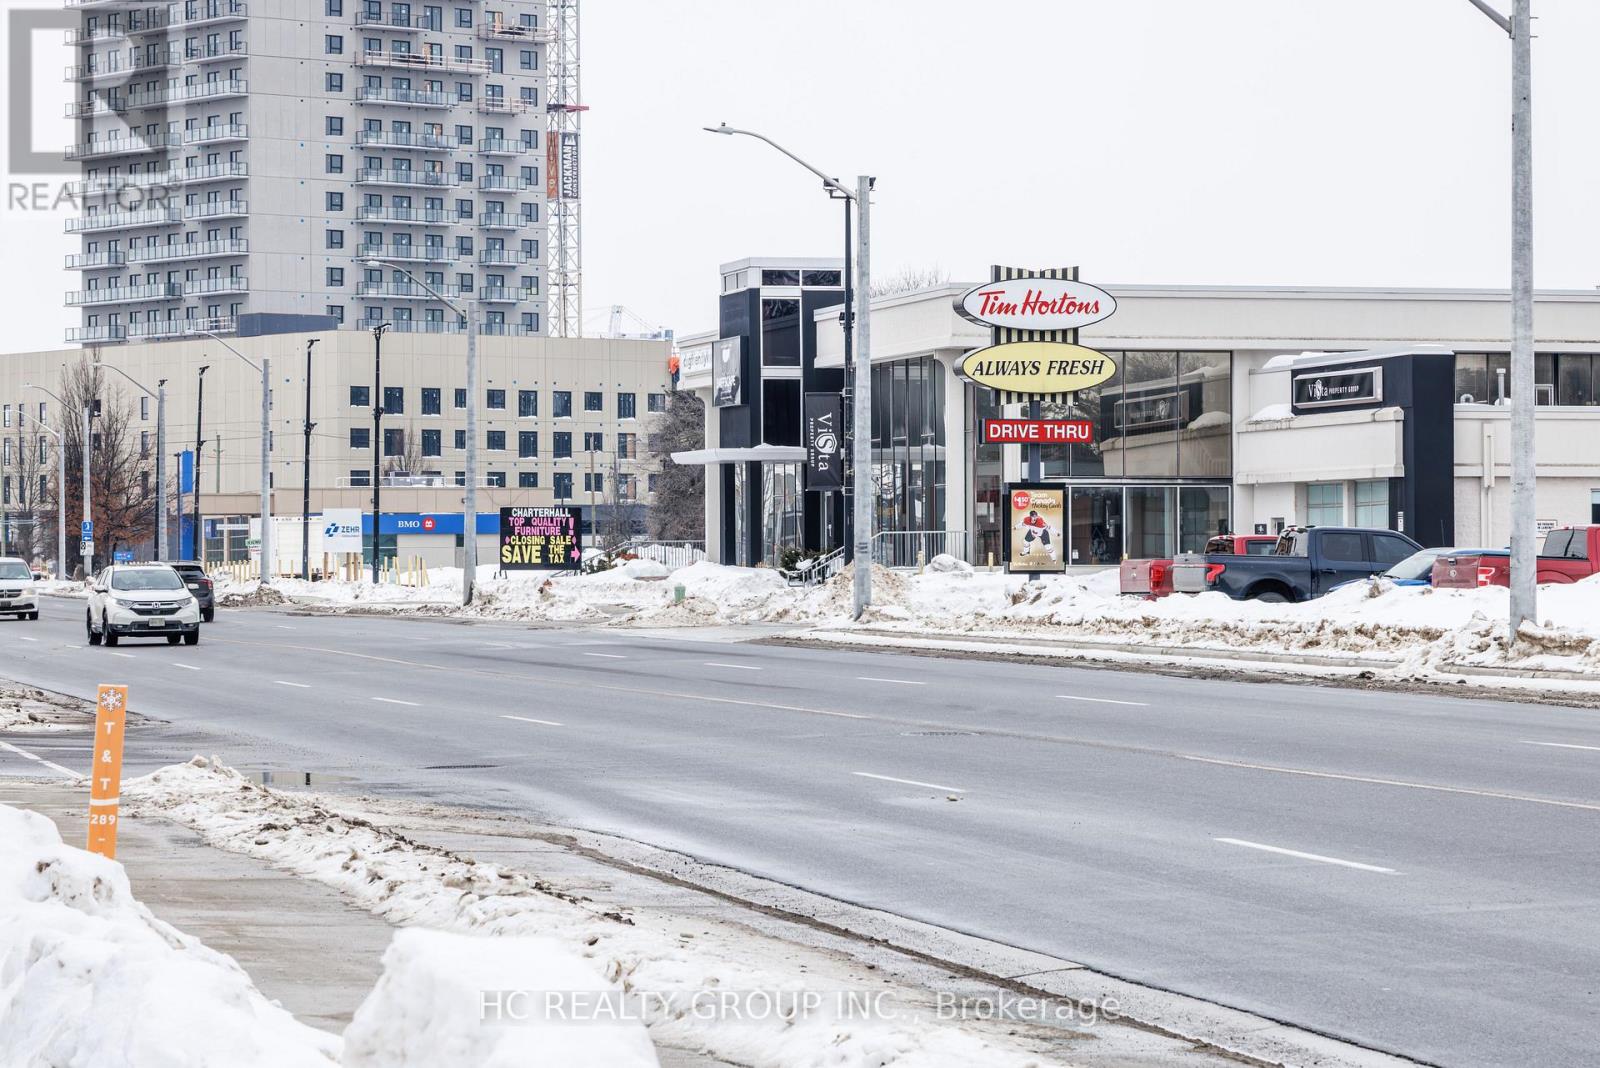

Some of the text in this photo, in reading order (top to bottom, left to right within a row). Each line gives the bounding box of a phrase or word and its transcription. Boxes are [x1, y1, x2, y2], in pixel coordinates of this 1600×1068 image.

[563, 145, 572, 197] JACKMAN
[978, 289, 1100, 316] Tim Hortons
[972, 359, 1105, 376] ALWAYS FRESH
[990, 424, 1089, 439] DRIVE THRU
[512, 508, 571, 518] CHARTERHALL
[397, 520, 420, 529] BMO
[509, 518, 525, 527] TOP
[532, 518, 567, 527] QUALITY
[515, 527, 561, 536] FURNITURE
[511, 536, 571, 545] CLOSING SALE
[502, 545, 565, 564] SAVE THE
[549, 555, 565, 564] TAX
[91, 814, 117, 825] 289
